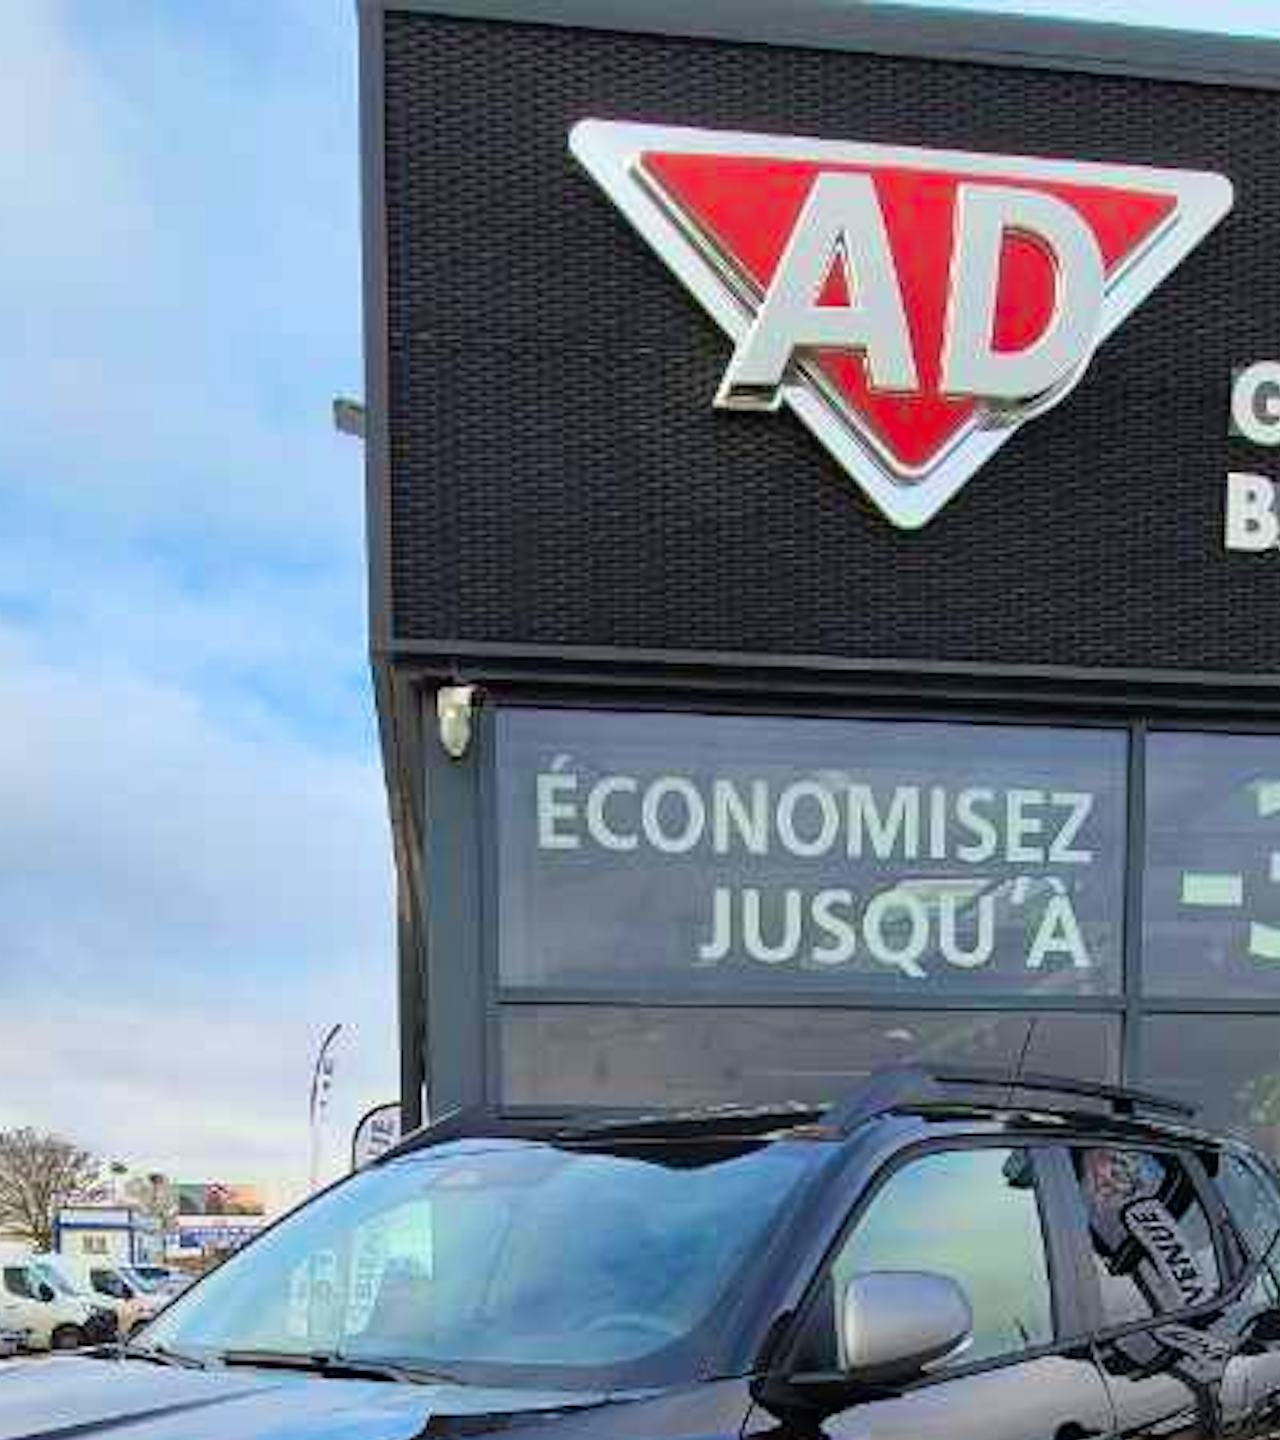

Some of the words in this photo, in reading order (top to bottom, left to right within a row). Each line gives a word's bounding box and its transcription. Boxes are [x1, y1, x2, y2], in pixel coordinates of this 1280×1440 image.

[714, 171, 1106, 409] AD
[535, 757, 1094, 863] ÉCONOMISEZ
[698, 876, 1093, 978] JUSQU'À
